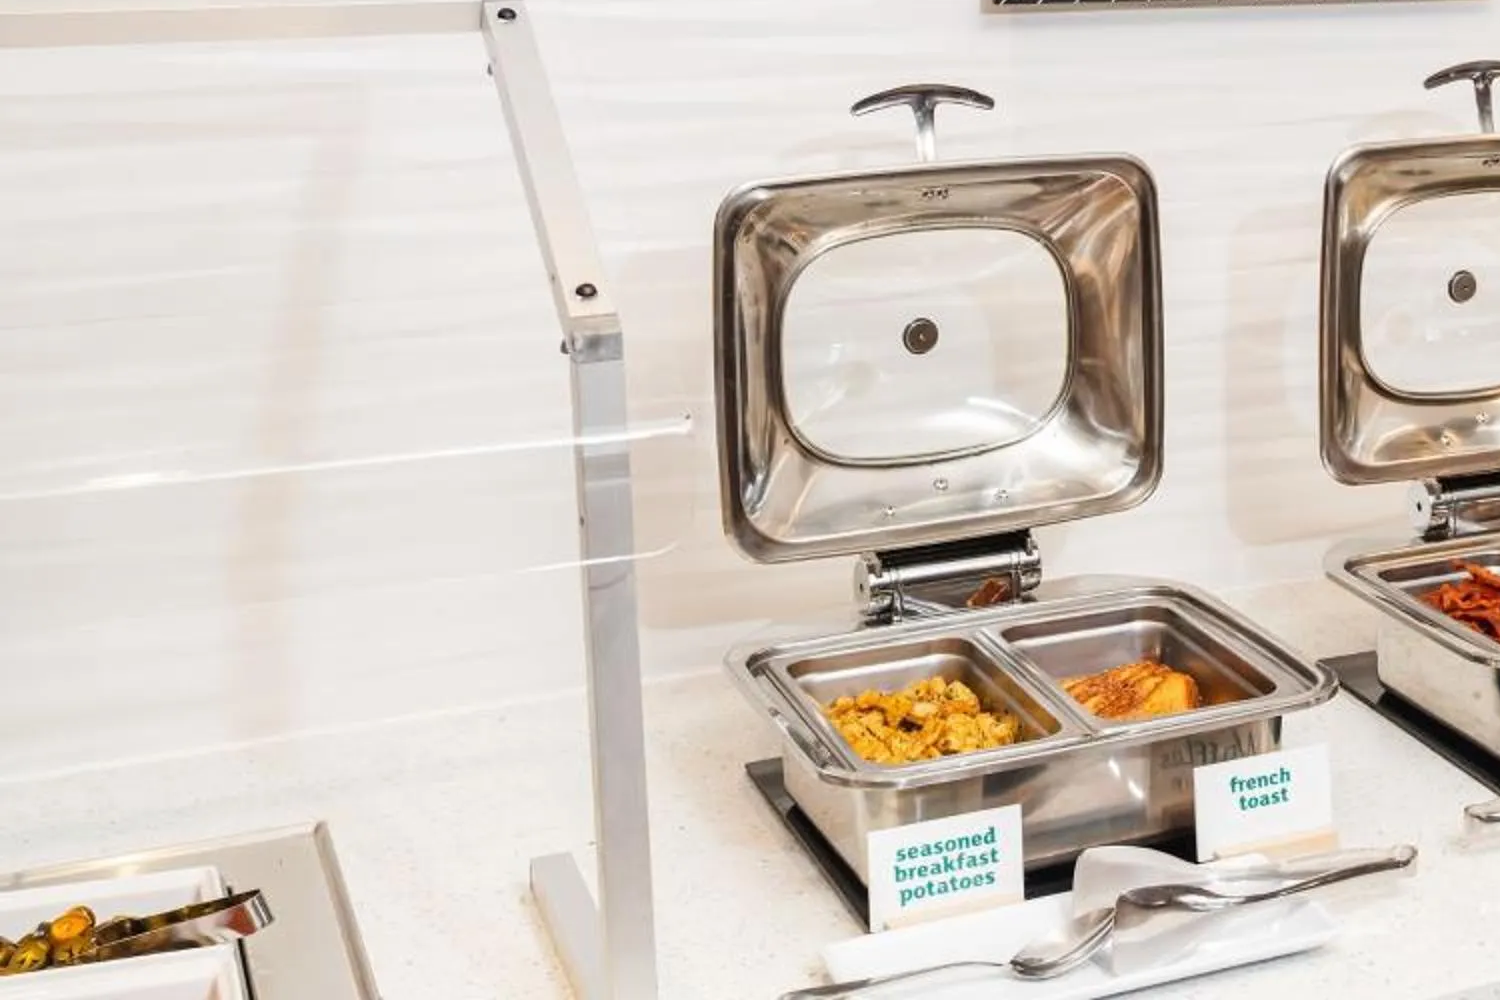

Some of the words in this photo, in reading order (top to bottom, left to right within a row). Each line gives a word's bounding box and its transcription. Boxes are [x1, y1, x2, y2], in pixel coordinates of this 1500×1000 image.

[1230, 767, 1292, 794] french
[1239, 788, 1290, 811] toast
[895, 826, 997, 863] seasoned
[894, 847, 999, 884] breakfast
[899, 869, 996, 906] potatoes
